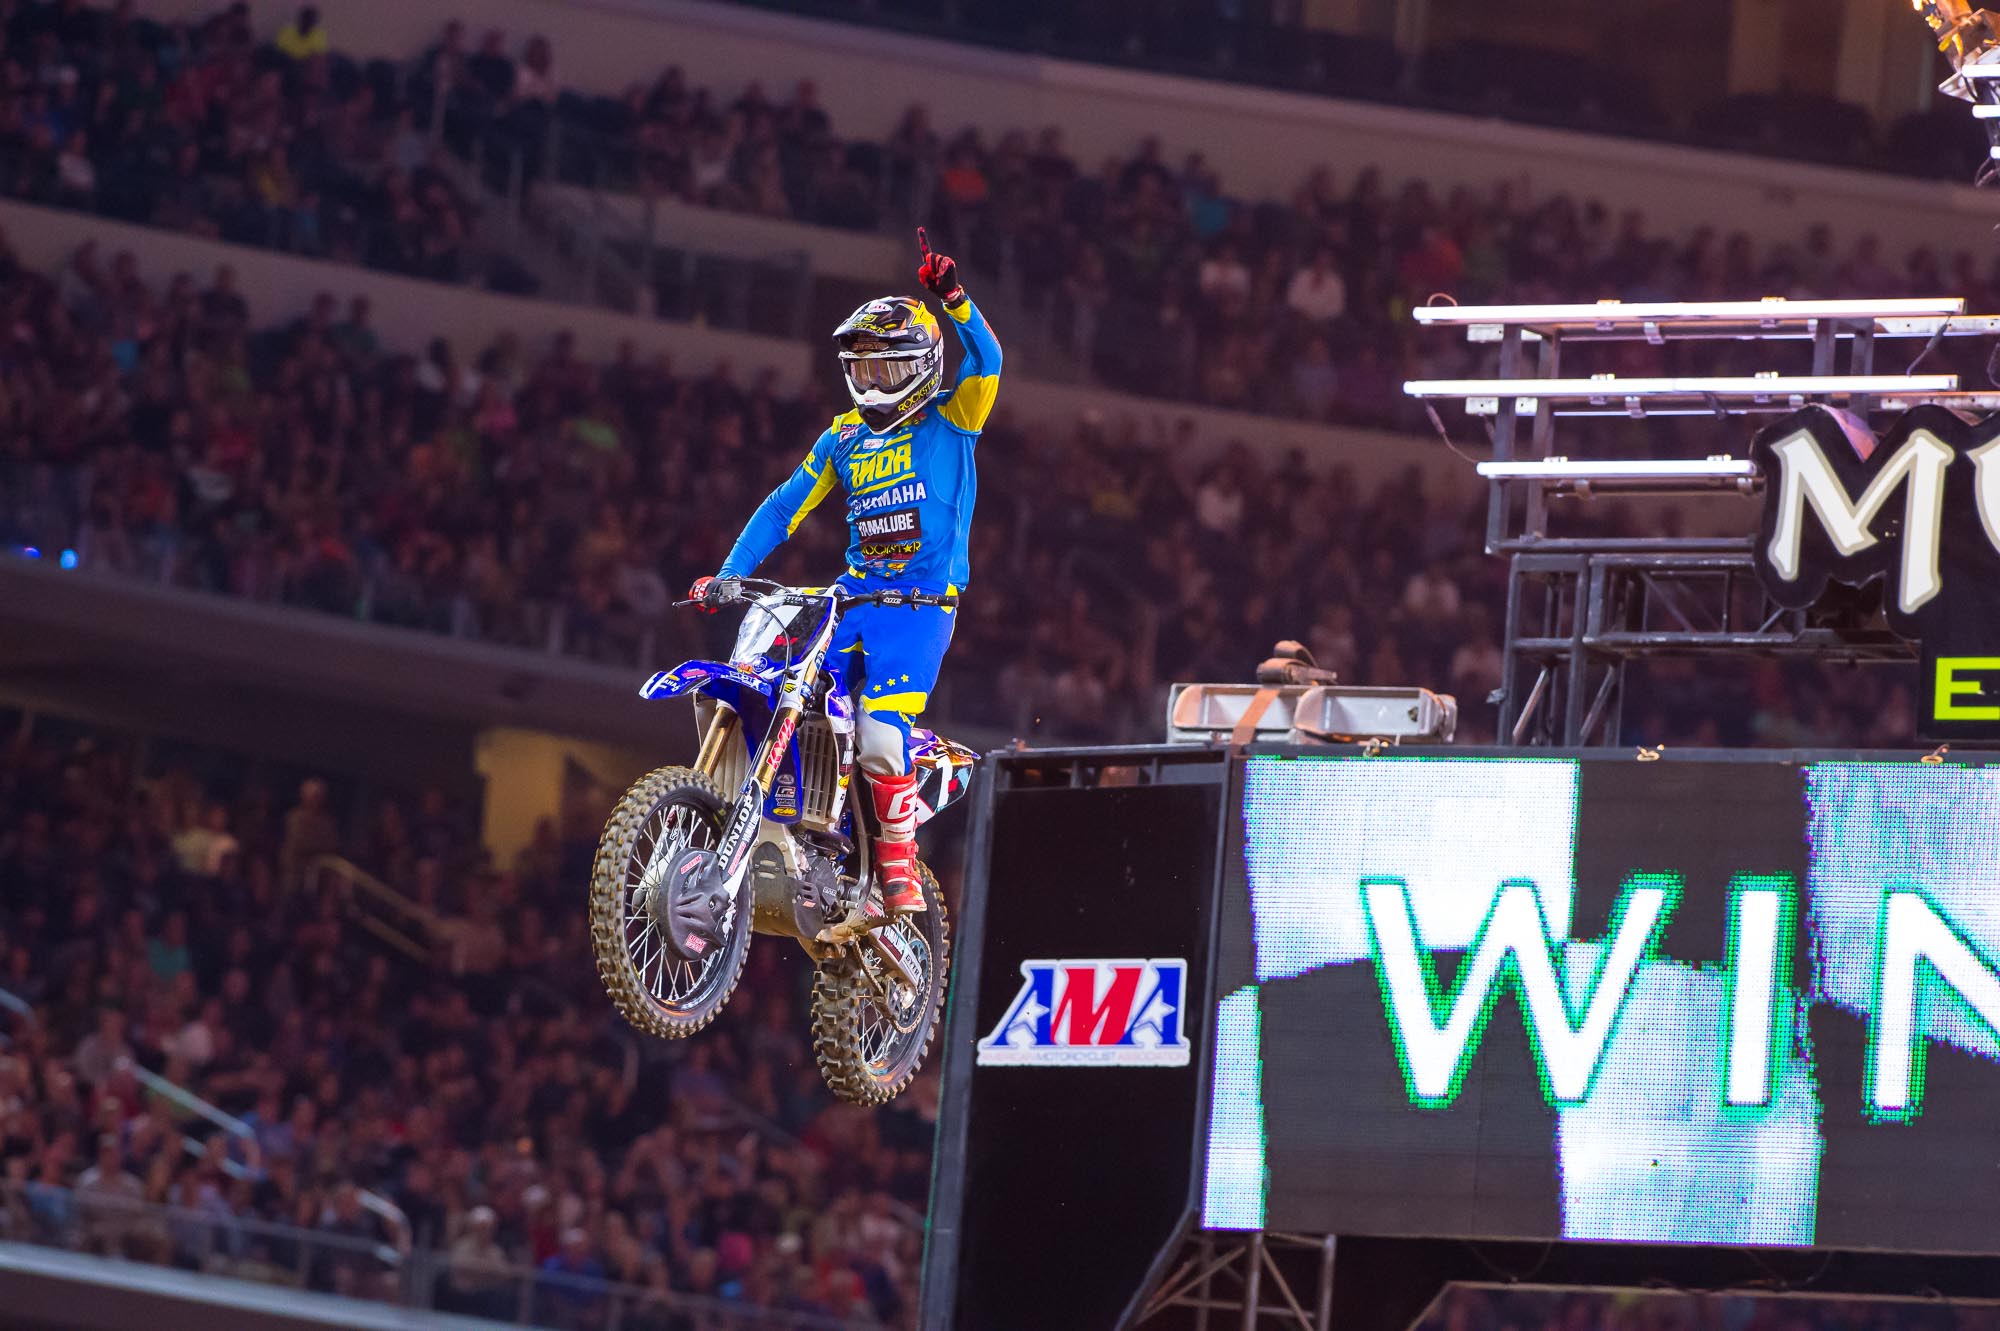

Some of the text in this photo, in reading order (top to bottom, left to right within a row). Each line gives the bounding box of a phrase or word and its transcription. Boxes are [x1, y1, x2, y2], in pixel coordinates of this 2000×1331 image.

[862, 481, 927, 510] YAMAHA
[1768, 428, 2000, 614] M
[718, 792, 754, 871] DUNLOP
[986, 965, 1184, 1047] AMA
